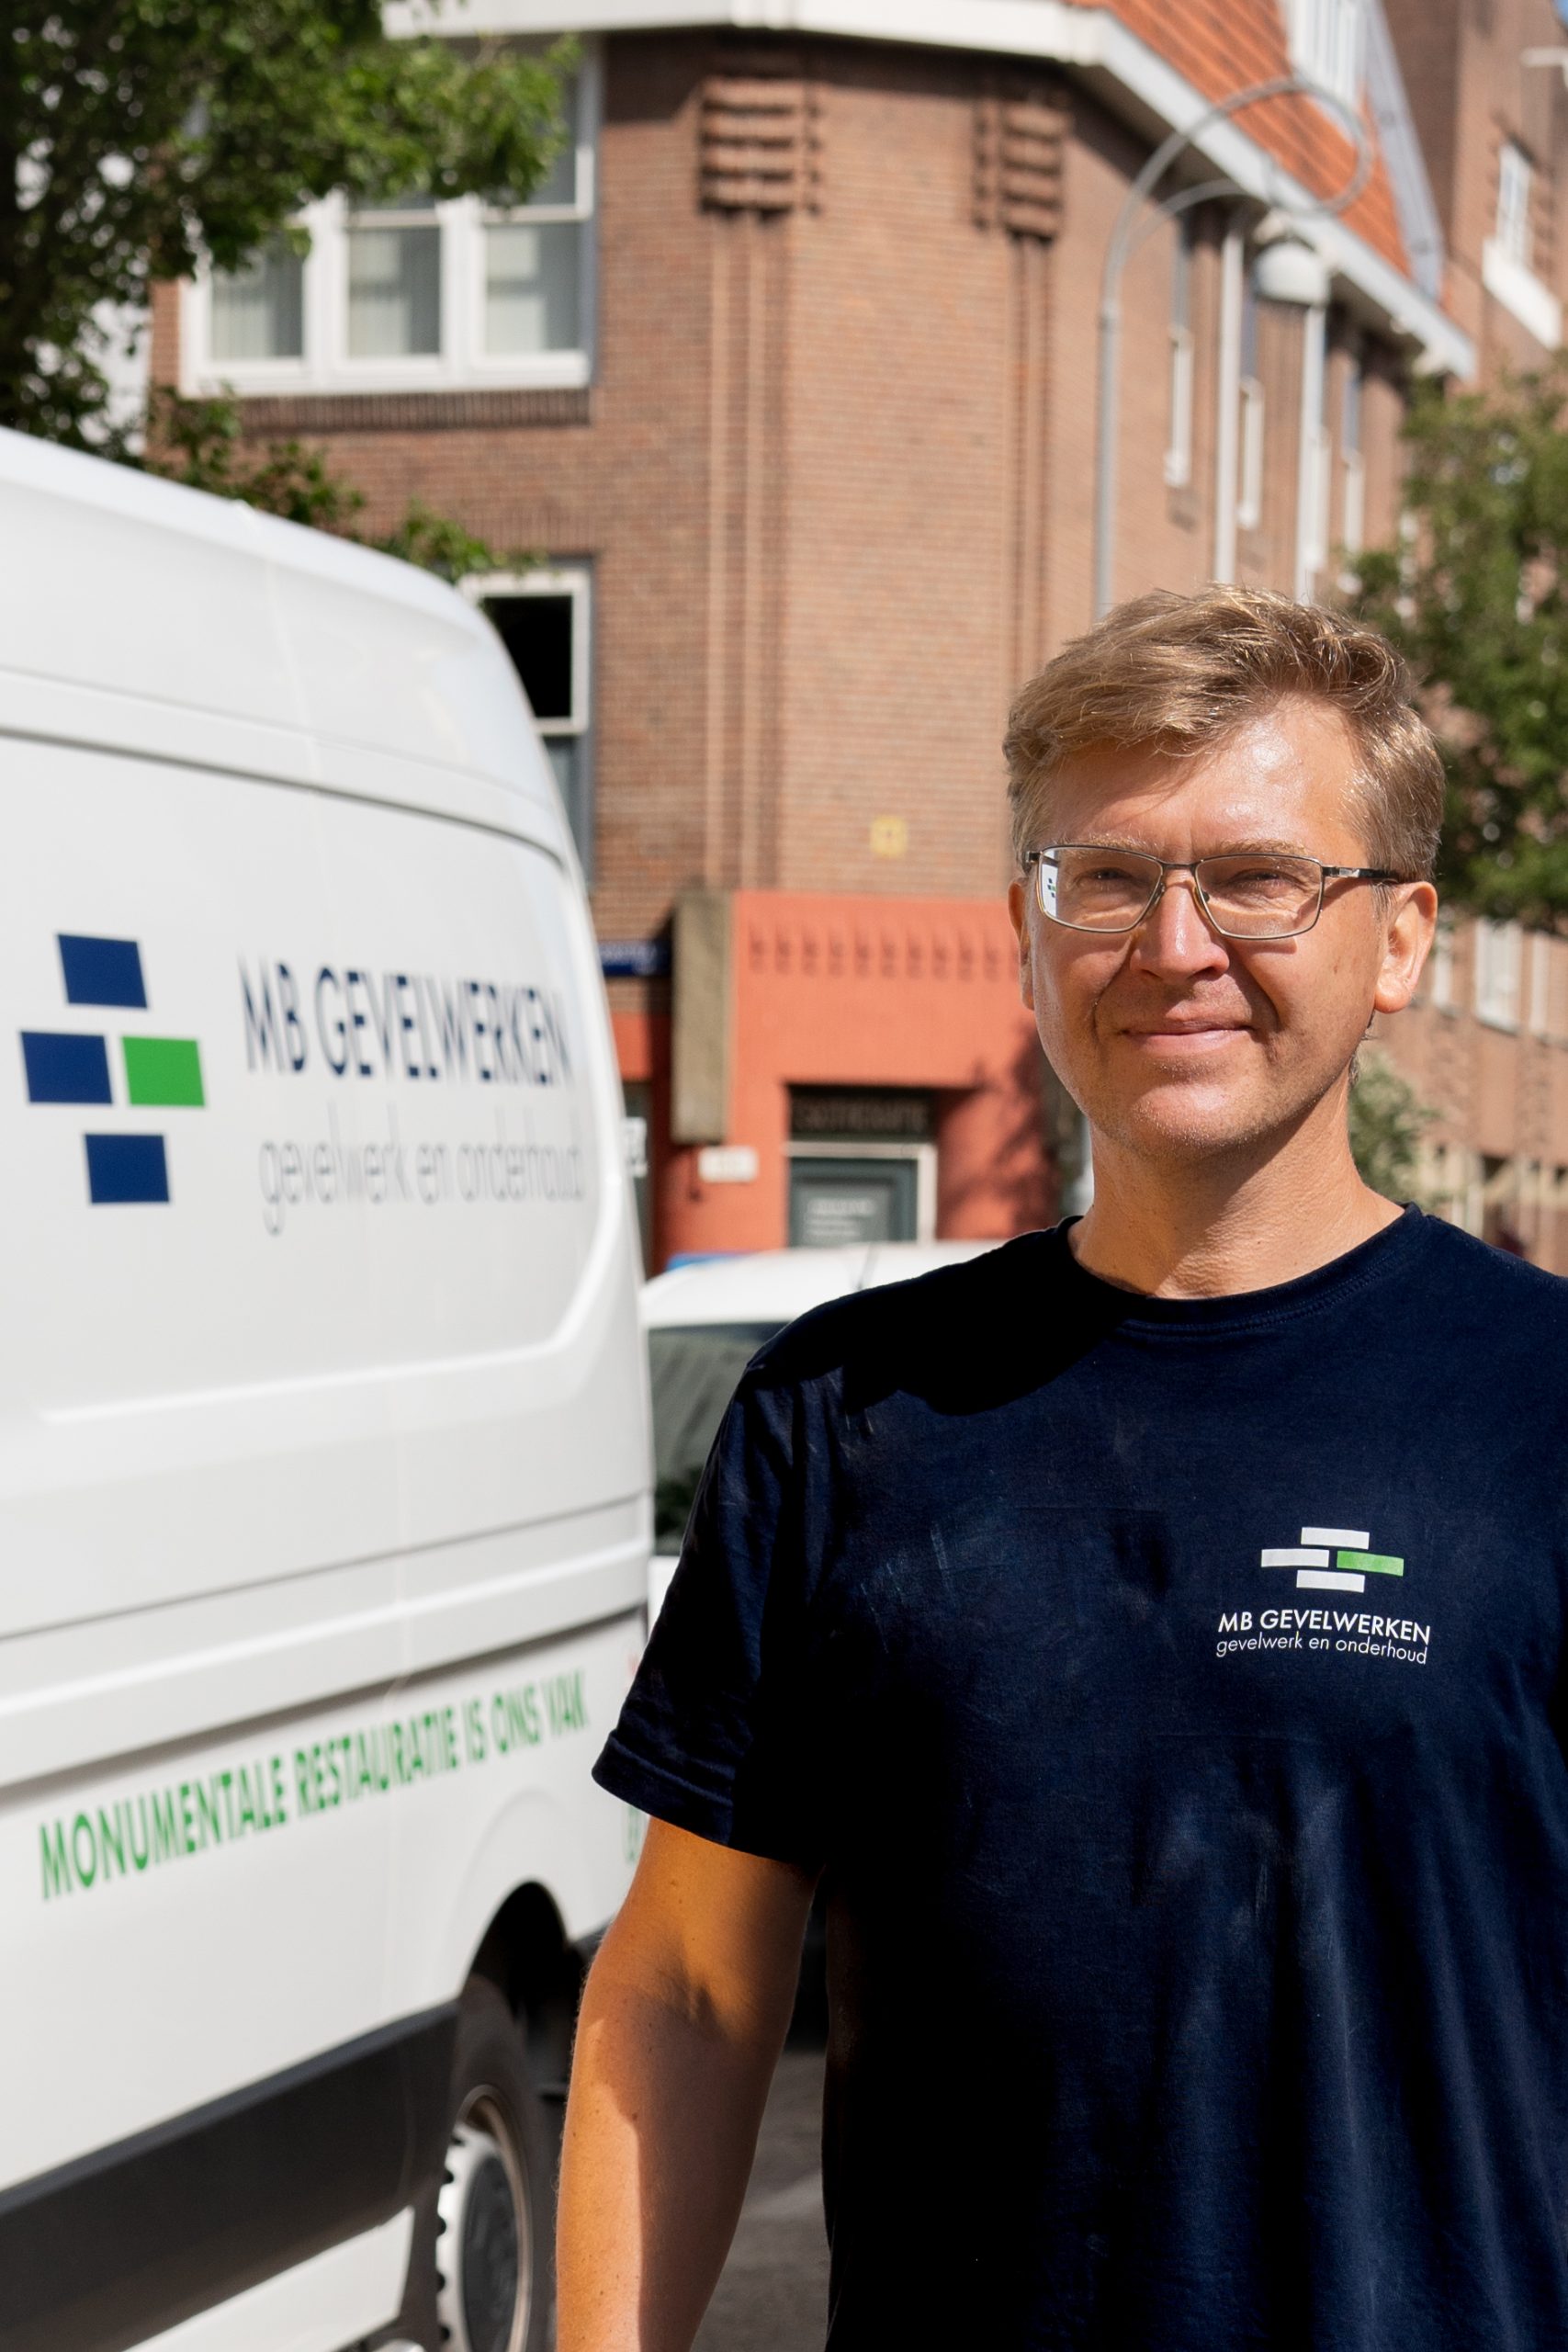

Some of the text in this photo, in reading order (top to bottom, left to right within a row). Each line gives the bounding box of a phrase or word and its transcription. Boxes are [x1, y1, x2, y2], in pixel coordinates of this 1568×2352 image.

[239, 958, 574, 1086] MB GEVELWERKEN
[258, 1104, 411, 1237] gevelwerk
[417, 1143, 449, 1204] en
[457, 1107, 585, 1203] onderhoud
[1216, 1632, 1428, 1665] gevelwerk en onderhoud
[1218, 1610, 1431, 1644] MB GEVELWERKEN
[40, 1672, 589, 1900] MONUMENTALE RESTAURATIE IS ONS VAK
